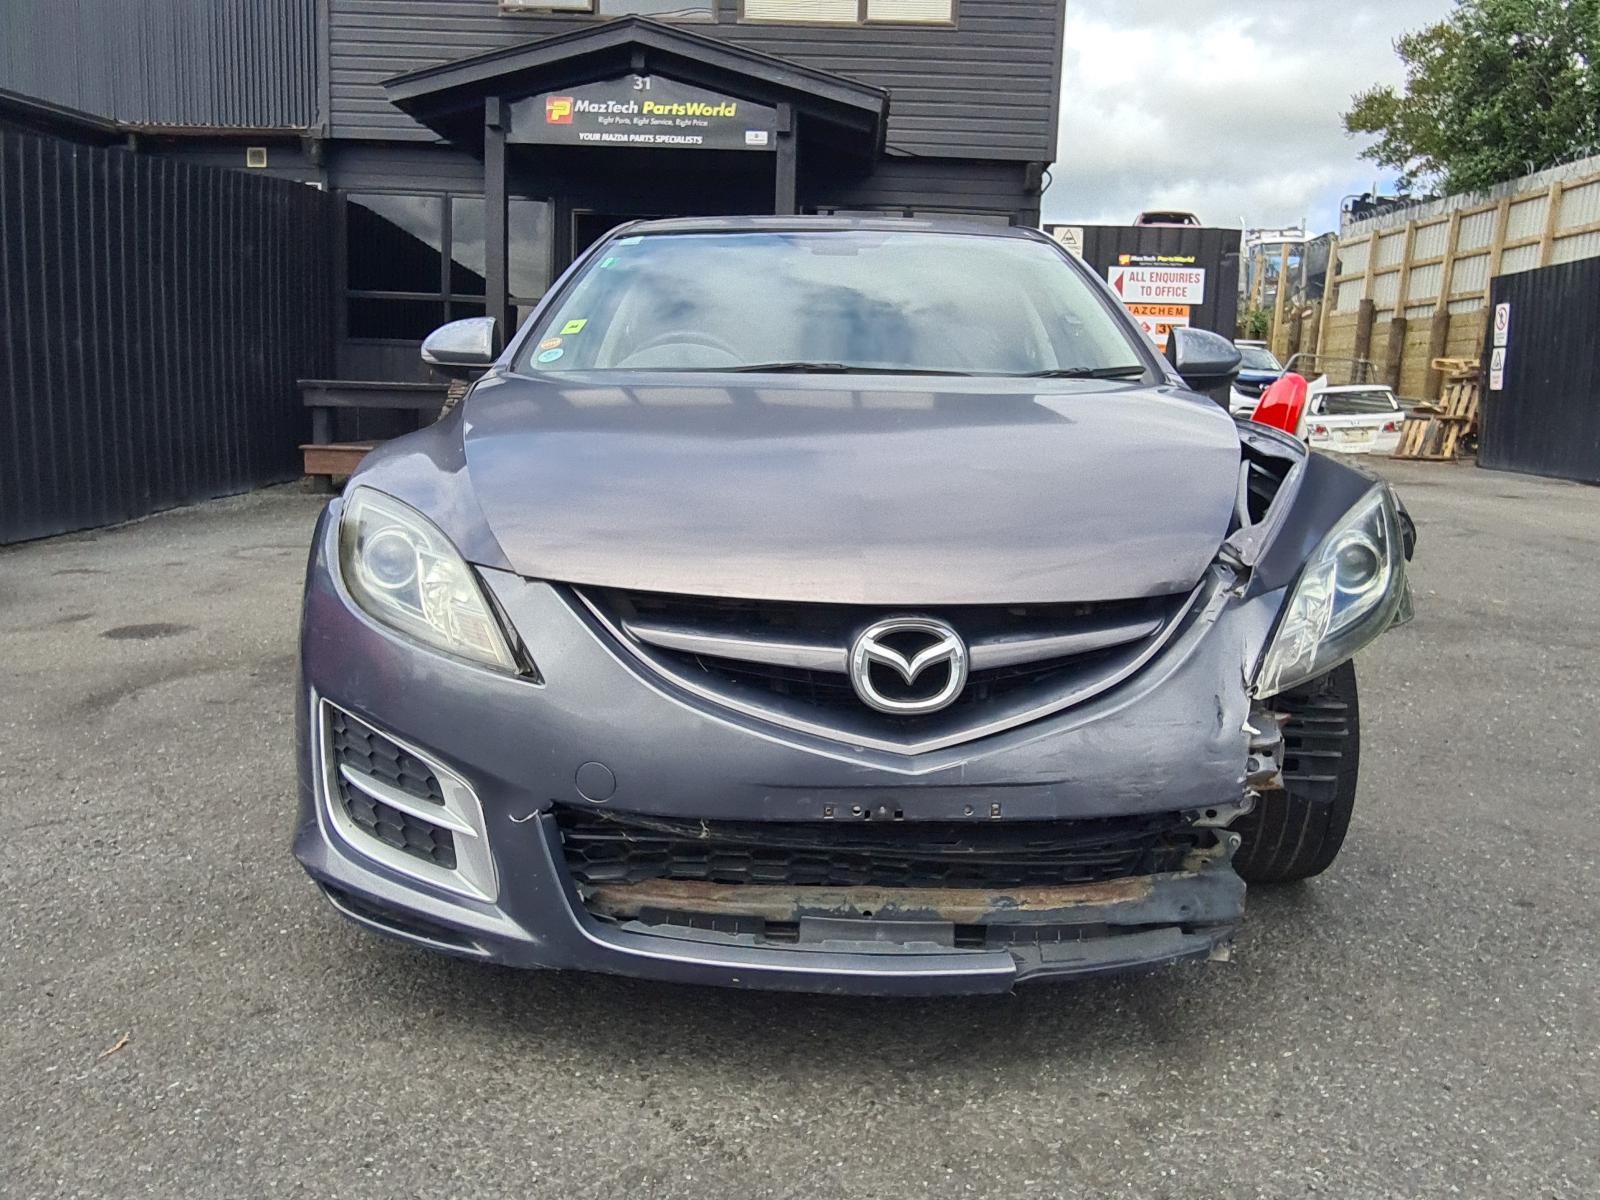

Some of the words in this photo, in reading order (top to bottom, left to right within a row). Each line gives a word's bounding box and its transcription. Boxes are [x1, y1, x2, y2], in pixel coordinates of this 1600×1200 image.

[633, 76, 651, 90] 31
[574, 100, 638, 114] MazTech
[643, 101, 737, 117] PartsWorld
[579, 133, 600, 141] YOUR
[601, 133, 628, 142] MAZDA
[629, 134, 654, 143] PARTS
[655, 134, 703, 144] SPECIALISTS
[1129, 272, 1146, 283] ALL
[1150, 272, 1200, 284] ENQUIRIES
[1140, 286, 1152, 297] TO
[1155, 286, 1187, 297] OFFICE
